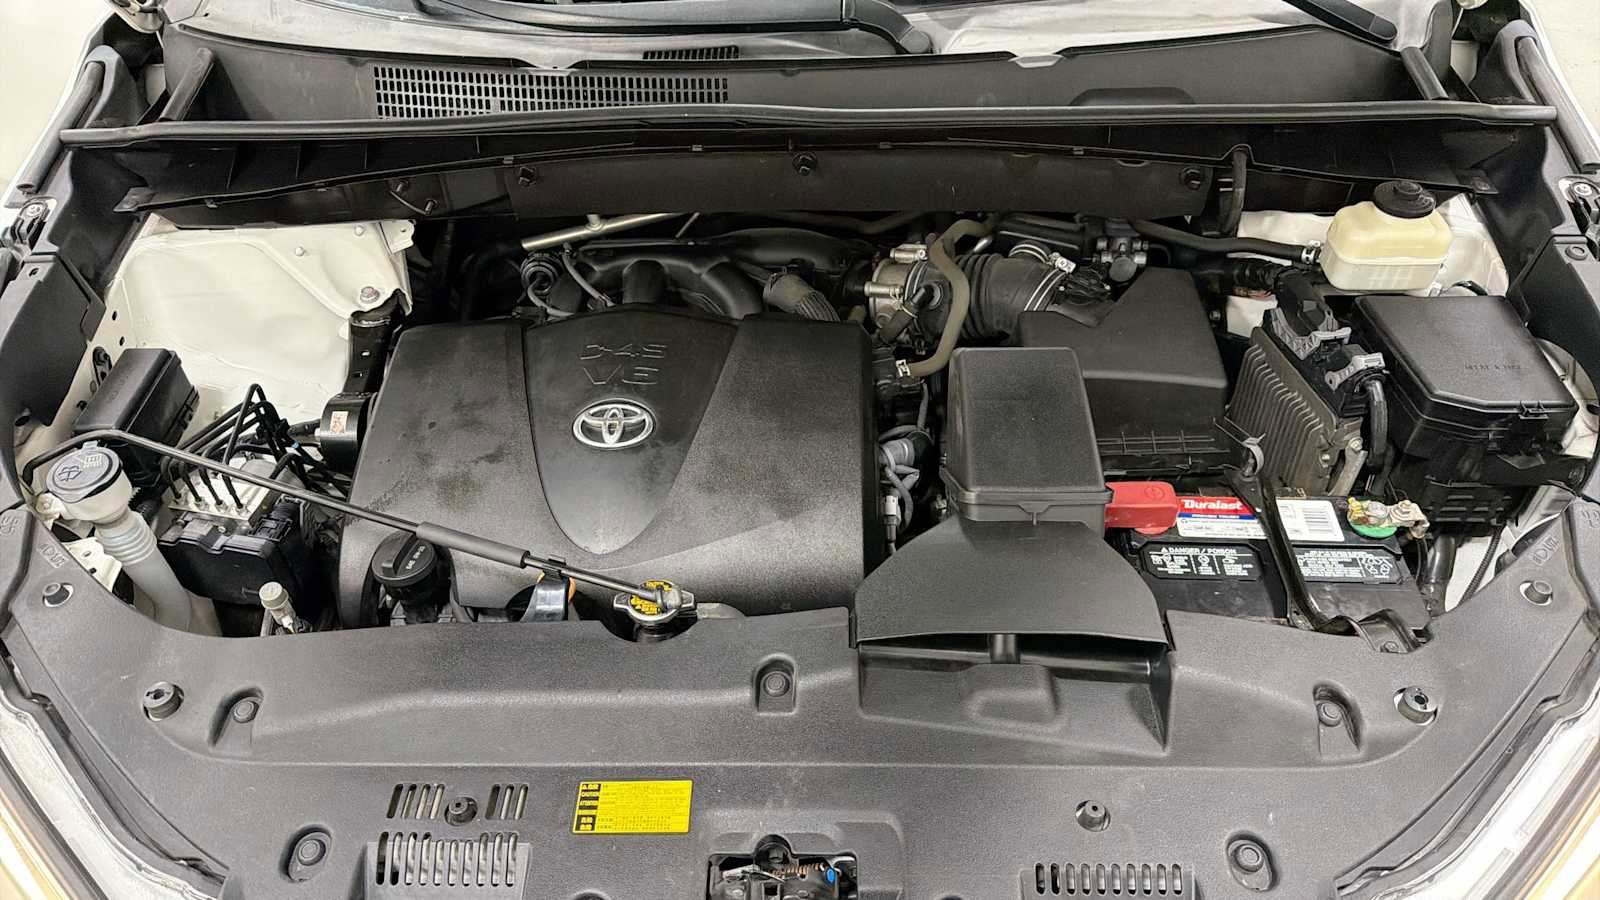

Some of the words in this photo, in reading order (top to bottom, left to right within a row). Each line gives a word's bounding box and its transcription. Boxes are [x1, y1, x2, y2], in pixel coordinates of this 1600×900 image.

[1181, 499, 1243, 510] Duralast
[1169, 547, 1200, 555] DANGER
[1207, 548, 1237, 556] POISON
